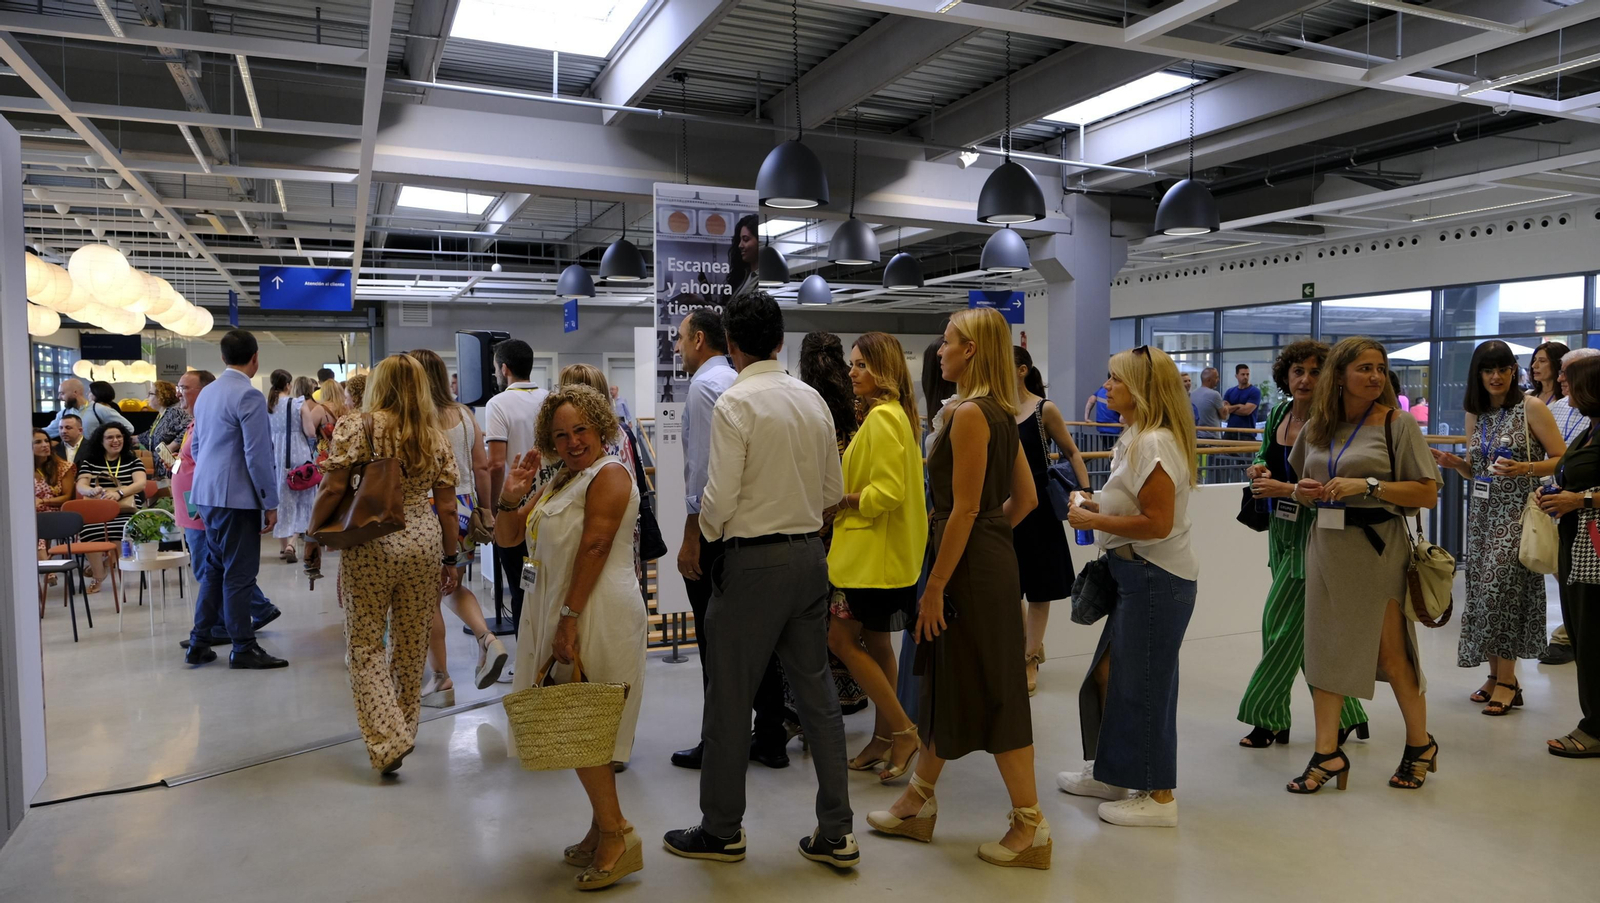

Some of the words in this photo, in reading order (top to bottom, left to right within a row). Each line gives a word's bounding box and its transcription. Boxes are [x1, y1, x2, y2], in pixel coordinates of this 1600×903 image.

[667, 257, 730, 274] Escanea
[667, 281, 676, 297] y
[680, 279, 733, 295] ahorra
[667, 300, 723, 316] tieo
